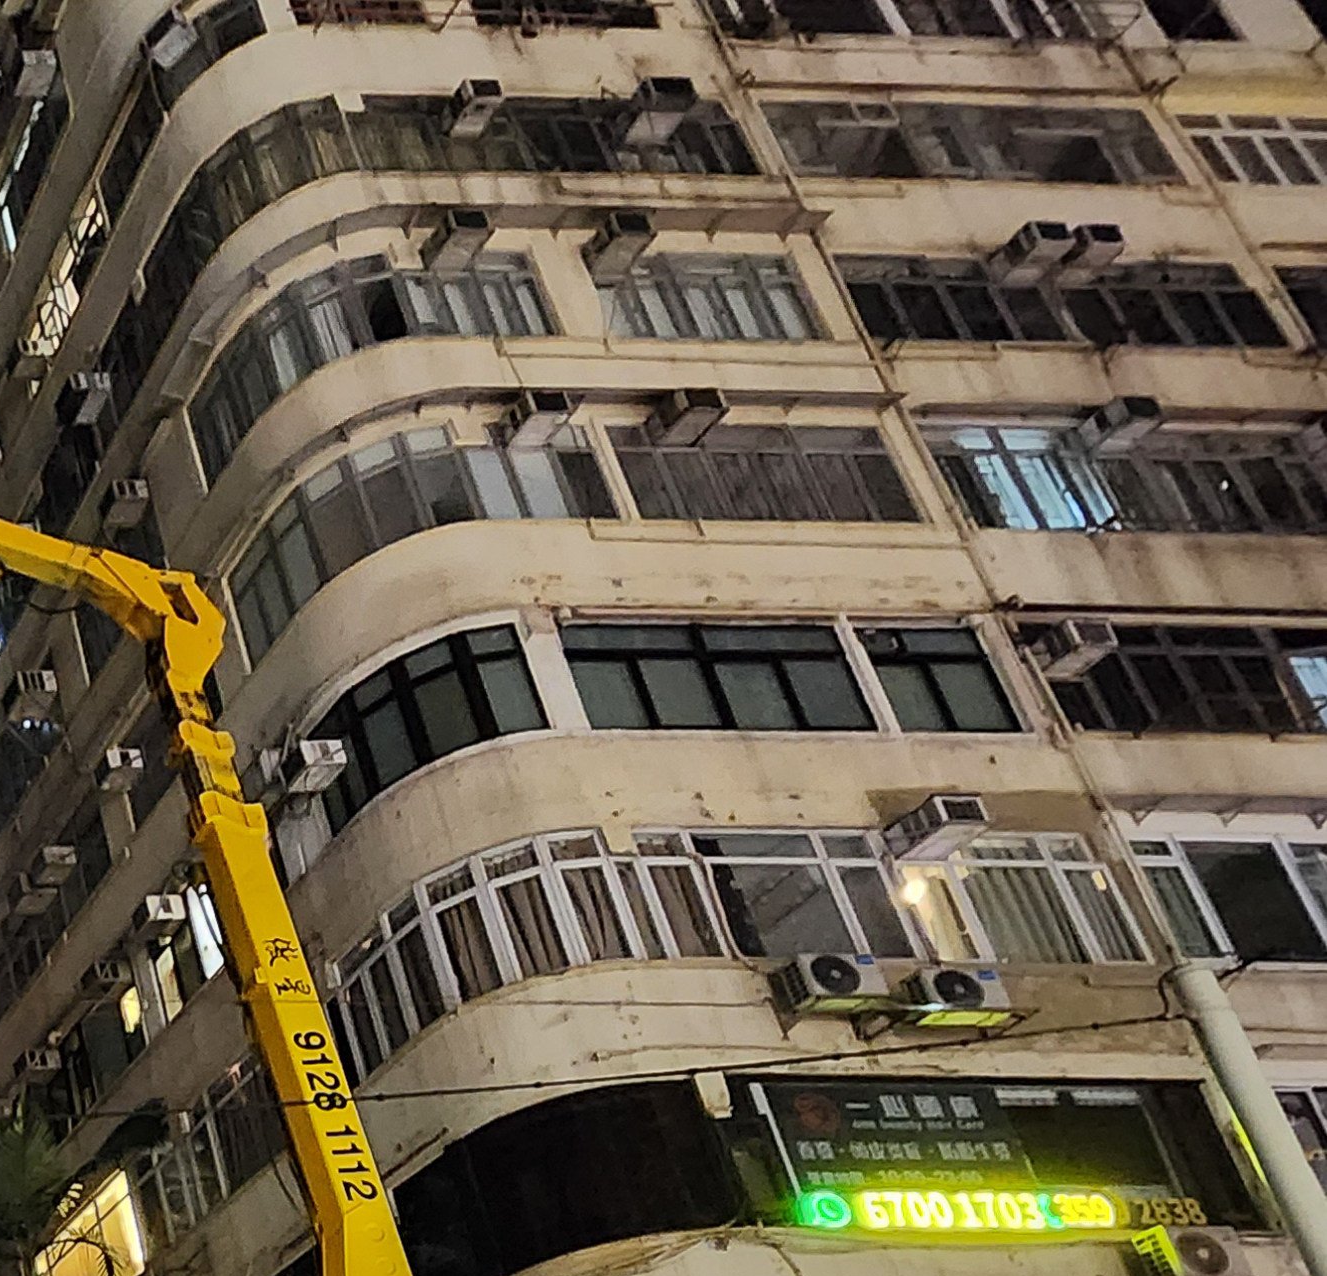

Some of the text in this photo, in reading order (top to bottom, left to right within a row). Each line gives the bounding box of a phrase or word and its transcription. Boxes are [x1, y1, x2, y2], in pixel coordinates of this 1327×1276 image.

[294, 1031, 378, 1201] 9128 1112
[865, 1190, 1046, 1228] 6700 1703
